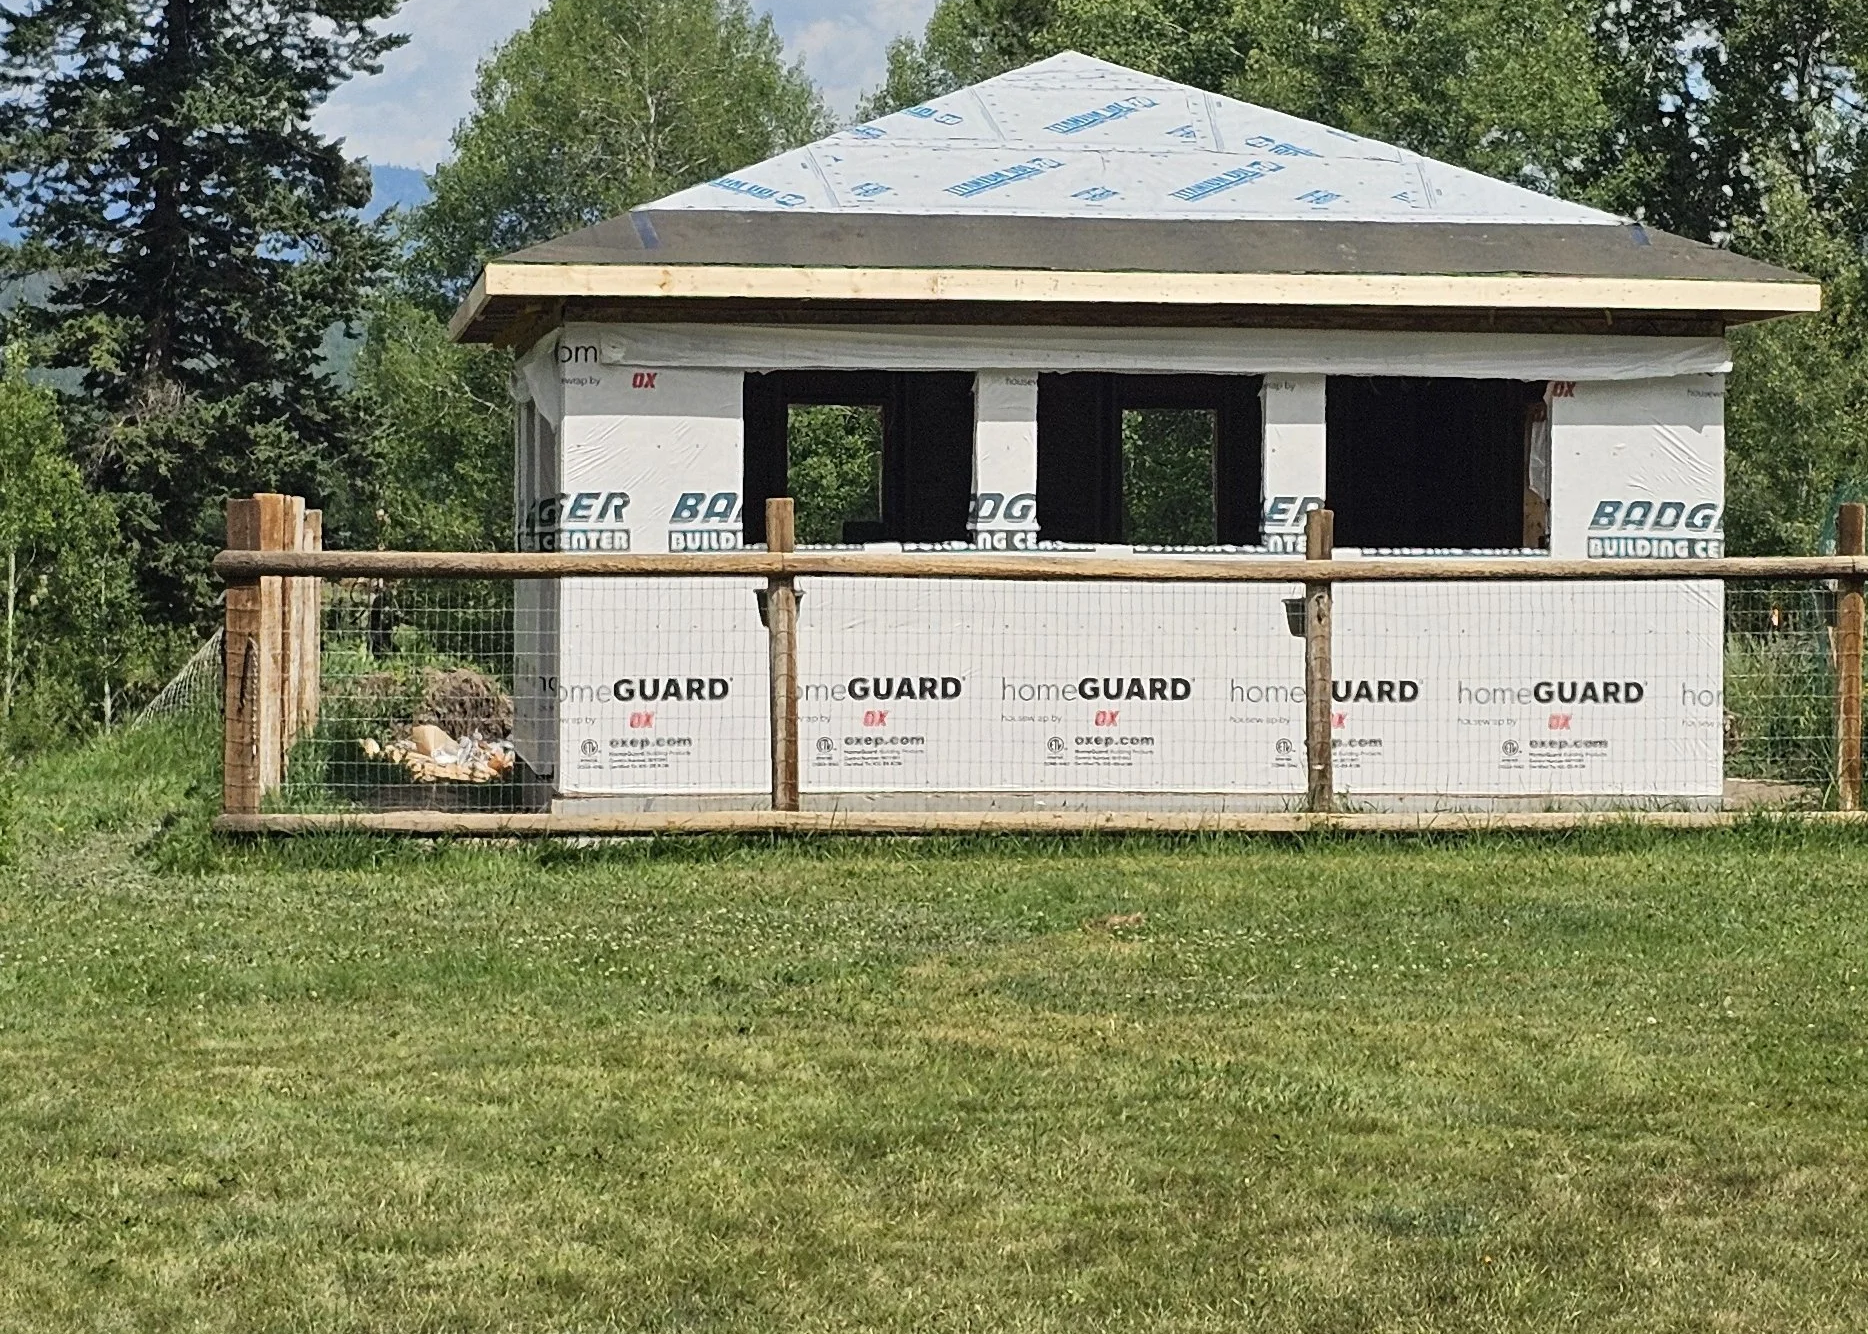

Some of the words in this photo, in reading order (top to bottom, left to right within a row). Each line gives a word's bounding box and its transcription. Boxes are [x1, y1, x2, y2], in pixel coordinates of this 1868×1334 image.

[631, 372, 658, 389] OX
[1551, 381, 1577, 398] OX
[538, 492, 630, 527] GER
[669, 492, 743, 524] BA
[1588, 538, 1689, 558] BUILDING
[1001, 676, 1192, 702] homeGUARD
[1457, 680, 1644, 705] homeGUARD
[628, 711, 655, 728] OX
[863, 709, 889, 727] OX
[1094, 709, 1120, 727] OX
[1547, 713, 1573, 730] OX
[608, 736, 693, 750] oxep.com
[843, 735, 925, 748] oxep.com
[1074, 735, 1155, 748] oxep.com
[1528, 738, 1609, 750] oxep.com
